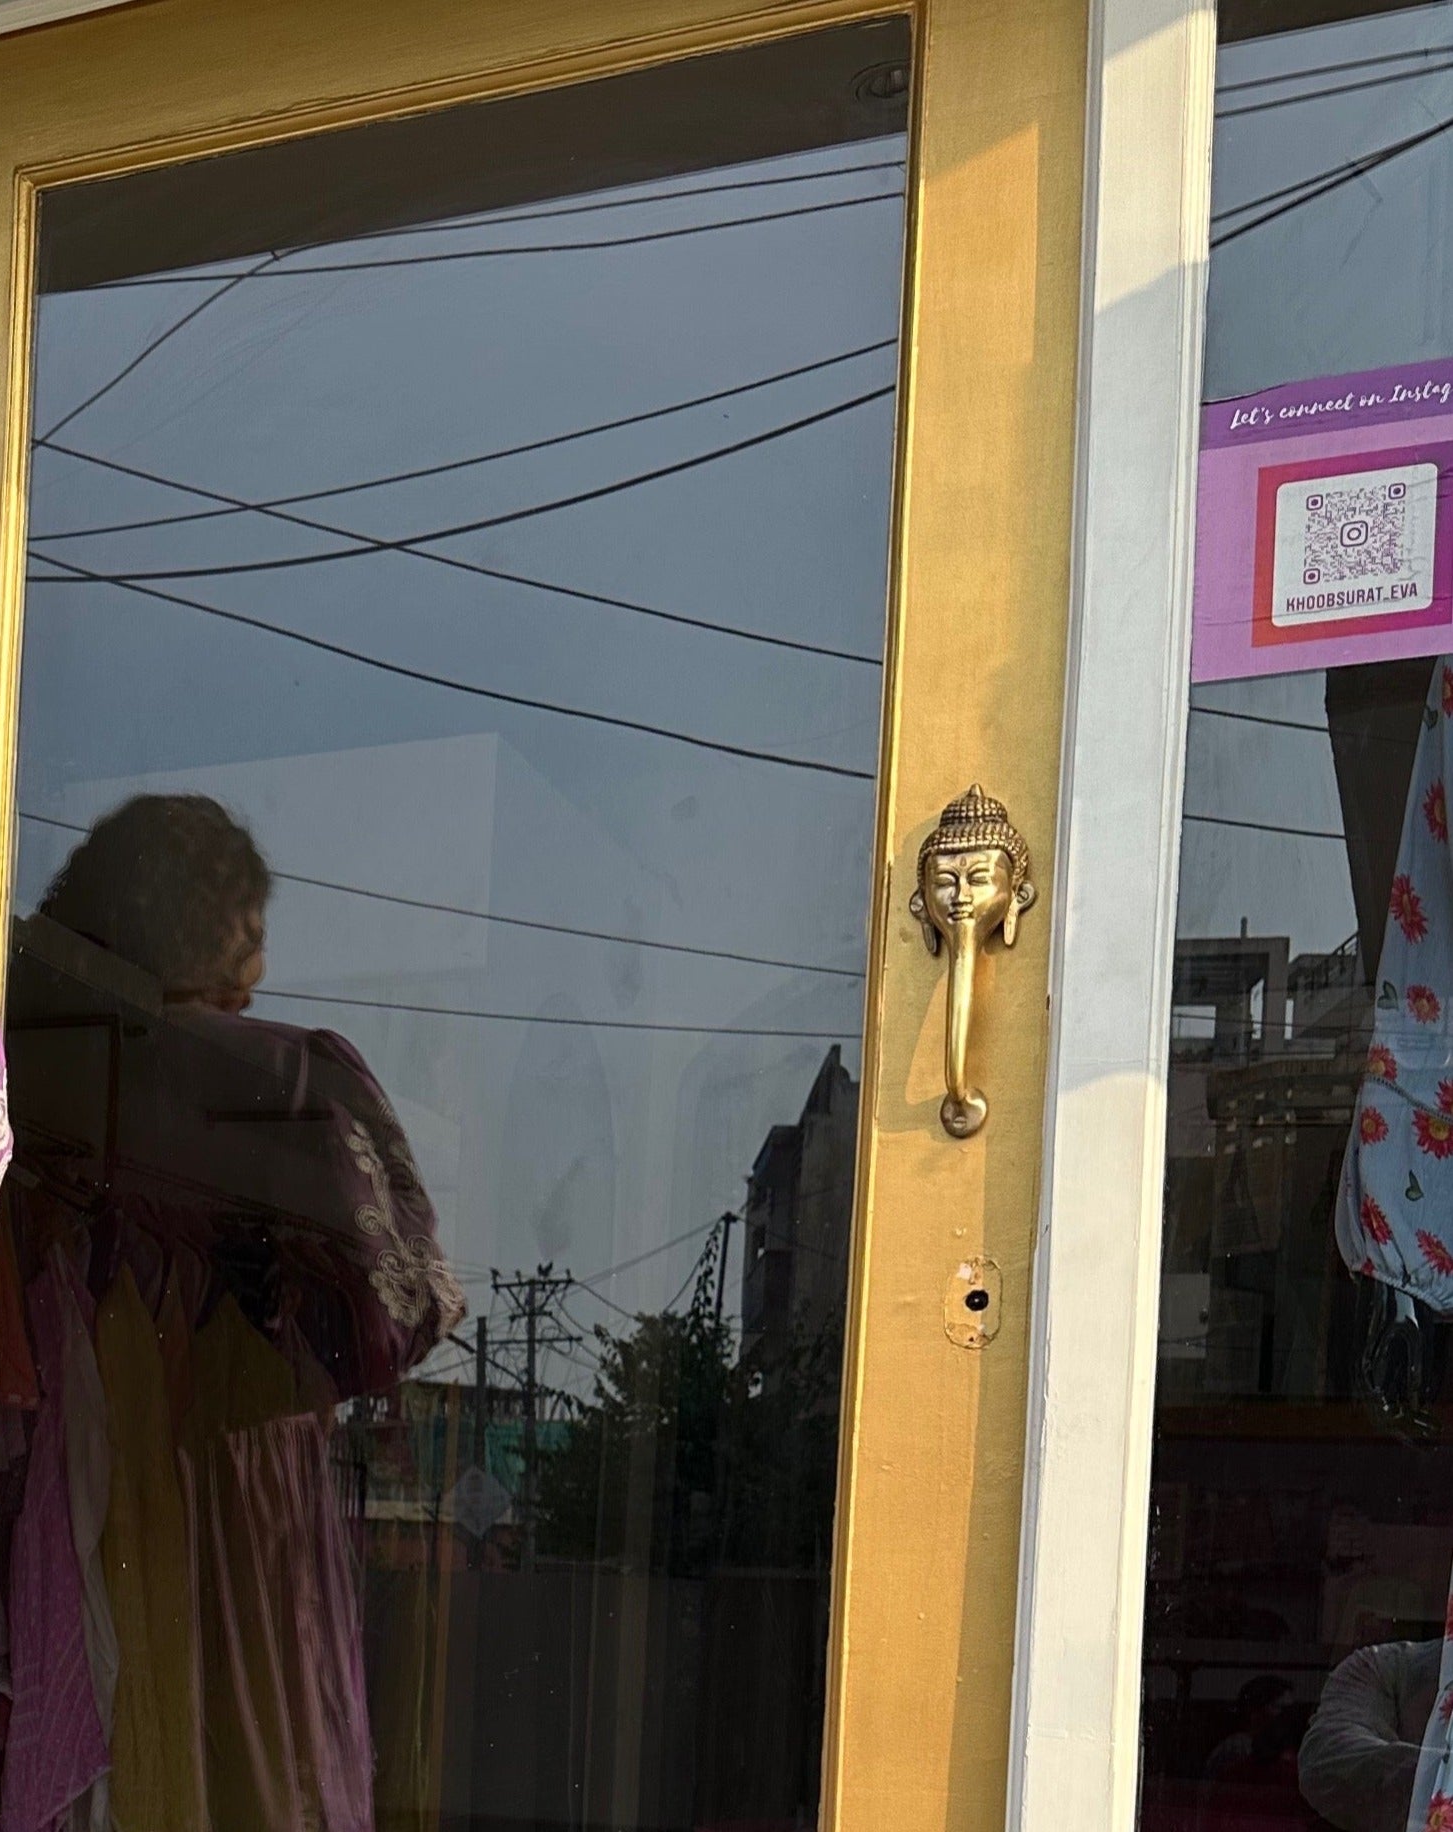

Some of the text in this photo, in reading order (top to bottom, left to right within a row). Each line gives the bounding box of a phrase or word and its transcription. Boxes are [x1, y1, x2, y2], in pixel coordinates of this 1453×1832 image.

[1229, 406, 1274, 430] Let's
[1279, 391, 1355, 418] connect
[1359, 393, 1386, 408] on
[1286, 582, 1418, 612] KHOOBSURAT_EVA
